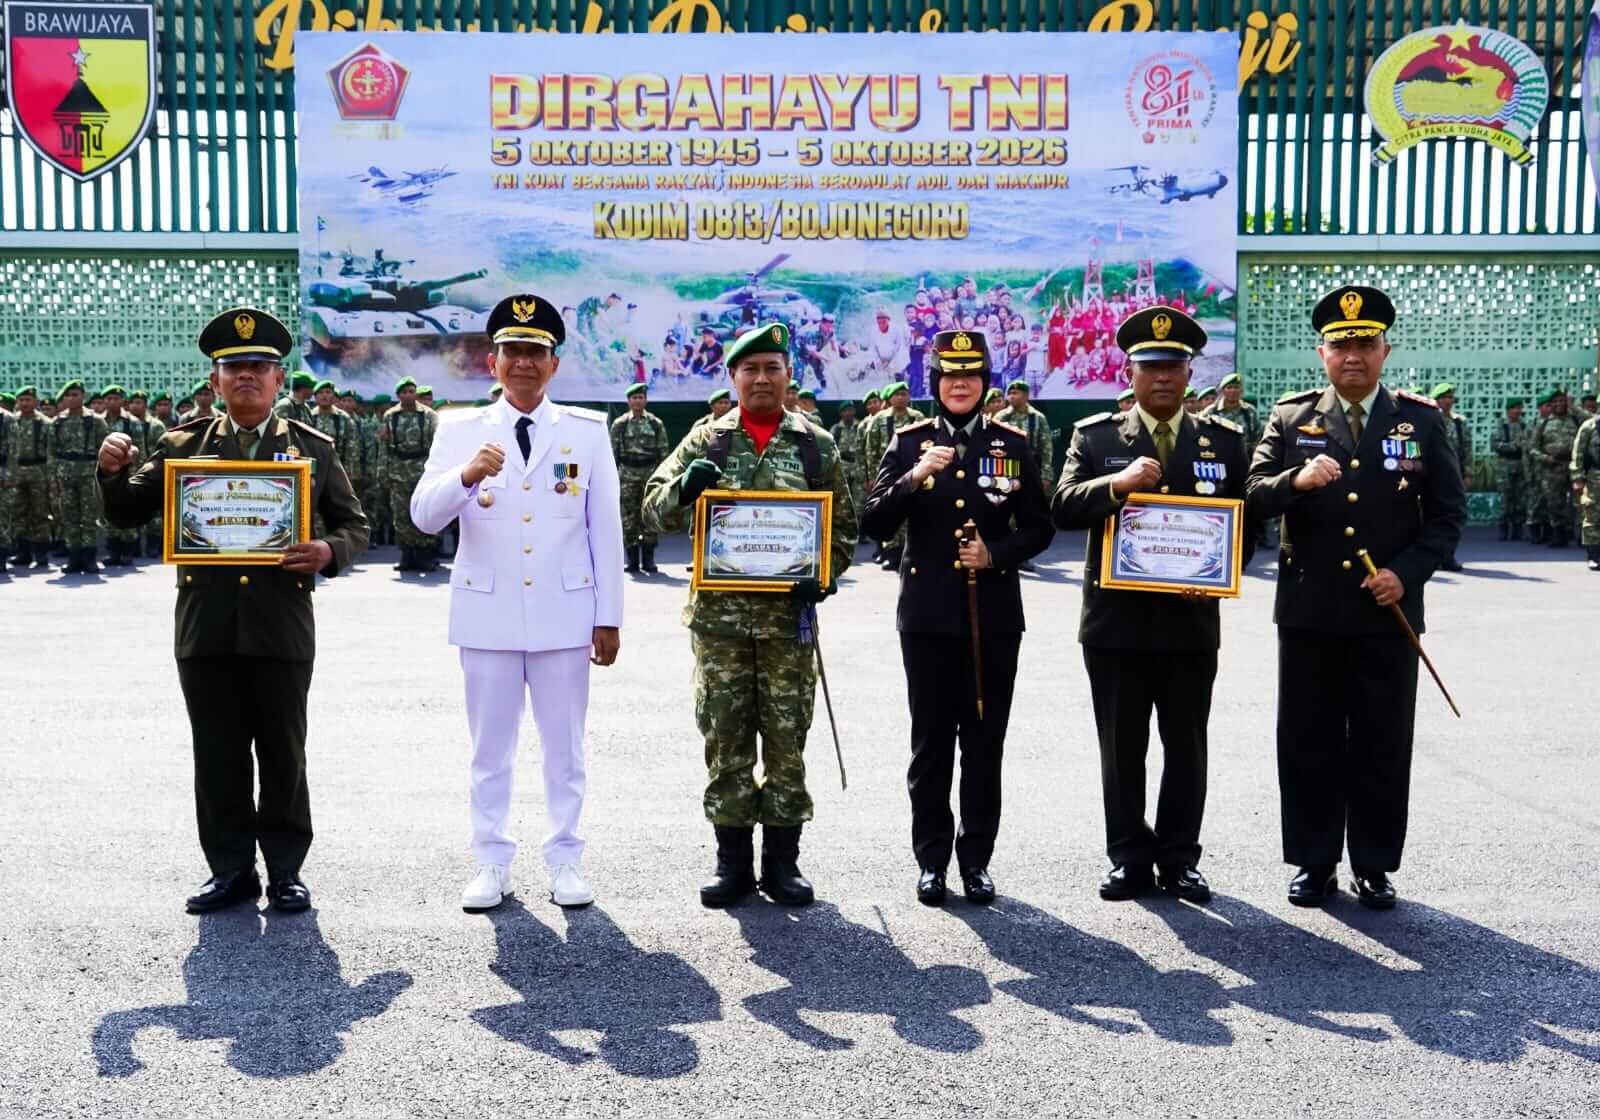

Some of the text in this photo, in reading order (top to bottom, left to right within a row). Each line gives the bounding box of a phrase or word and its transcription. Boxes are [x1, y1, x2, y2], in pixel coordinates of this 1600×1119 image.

[24, 12, 135, 34] BRAWIJAYA
[489, 73, 1069, 132] DIRGAHAYU TNI
[1147, 119, 1193, 129] PRIMA
[1394, 131, 1421, 146] CITRA
[1425, 127, 1454, 136] PANCA
[1491, 132, 1512, 146] JAYA
[490, 137, 521, 166] 5
[529, 140, 672, 166] OKTOBER
[676, 137, 761, 166] 1945
[797, 137, 823, 166] 5
[830, 140, 972, 166] OKTOBER
[975, 137, 1068, 166] 2026
[491, 174, 1069, 193] TNI KUAT BERSAMA RAKYAT, INDONESIA BERDAULAT ADIL DAN MAKMUR
[593, 200, 969, 244] KODIM 0813/BOJONEGORO
[783, 461, 800, 471] TNI
